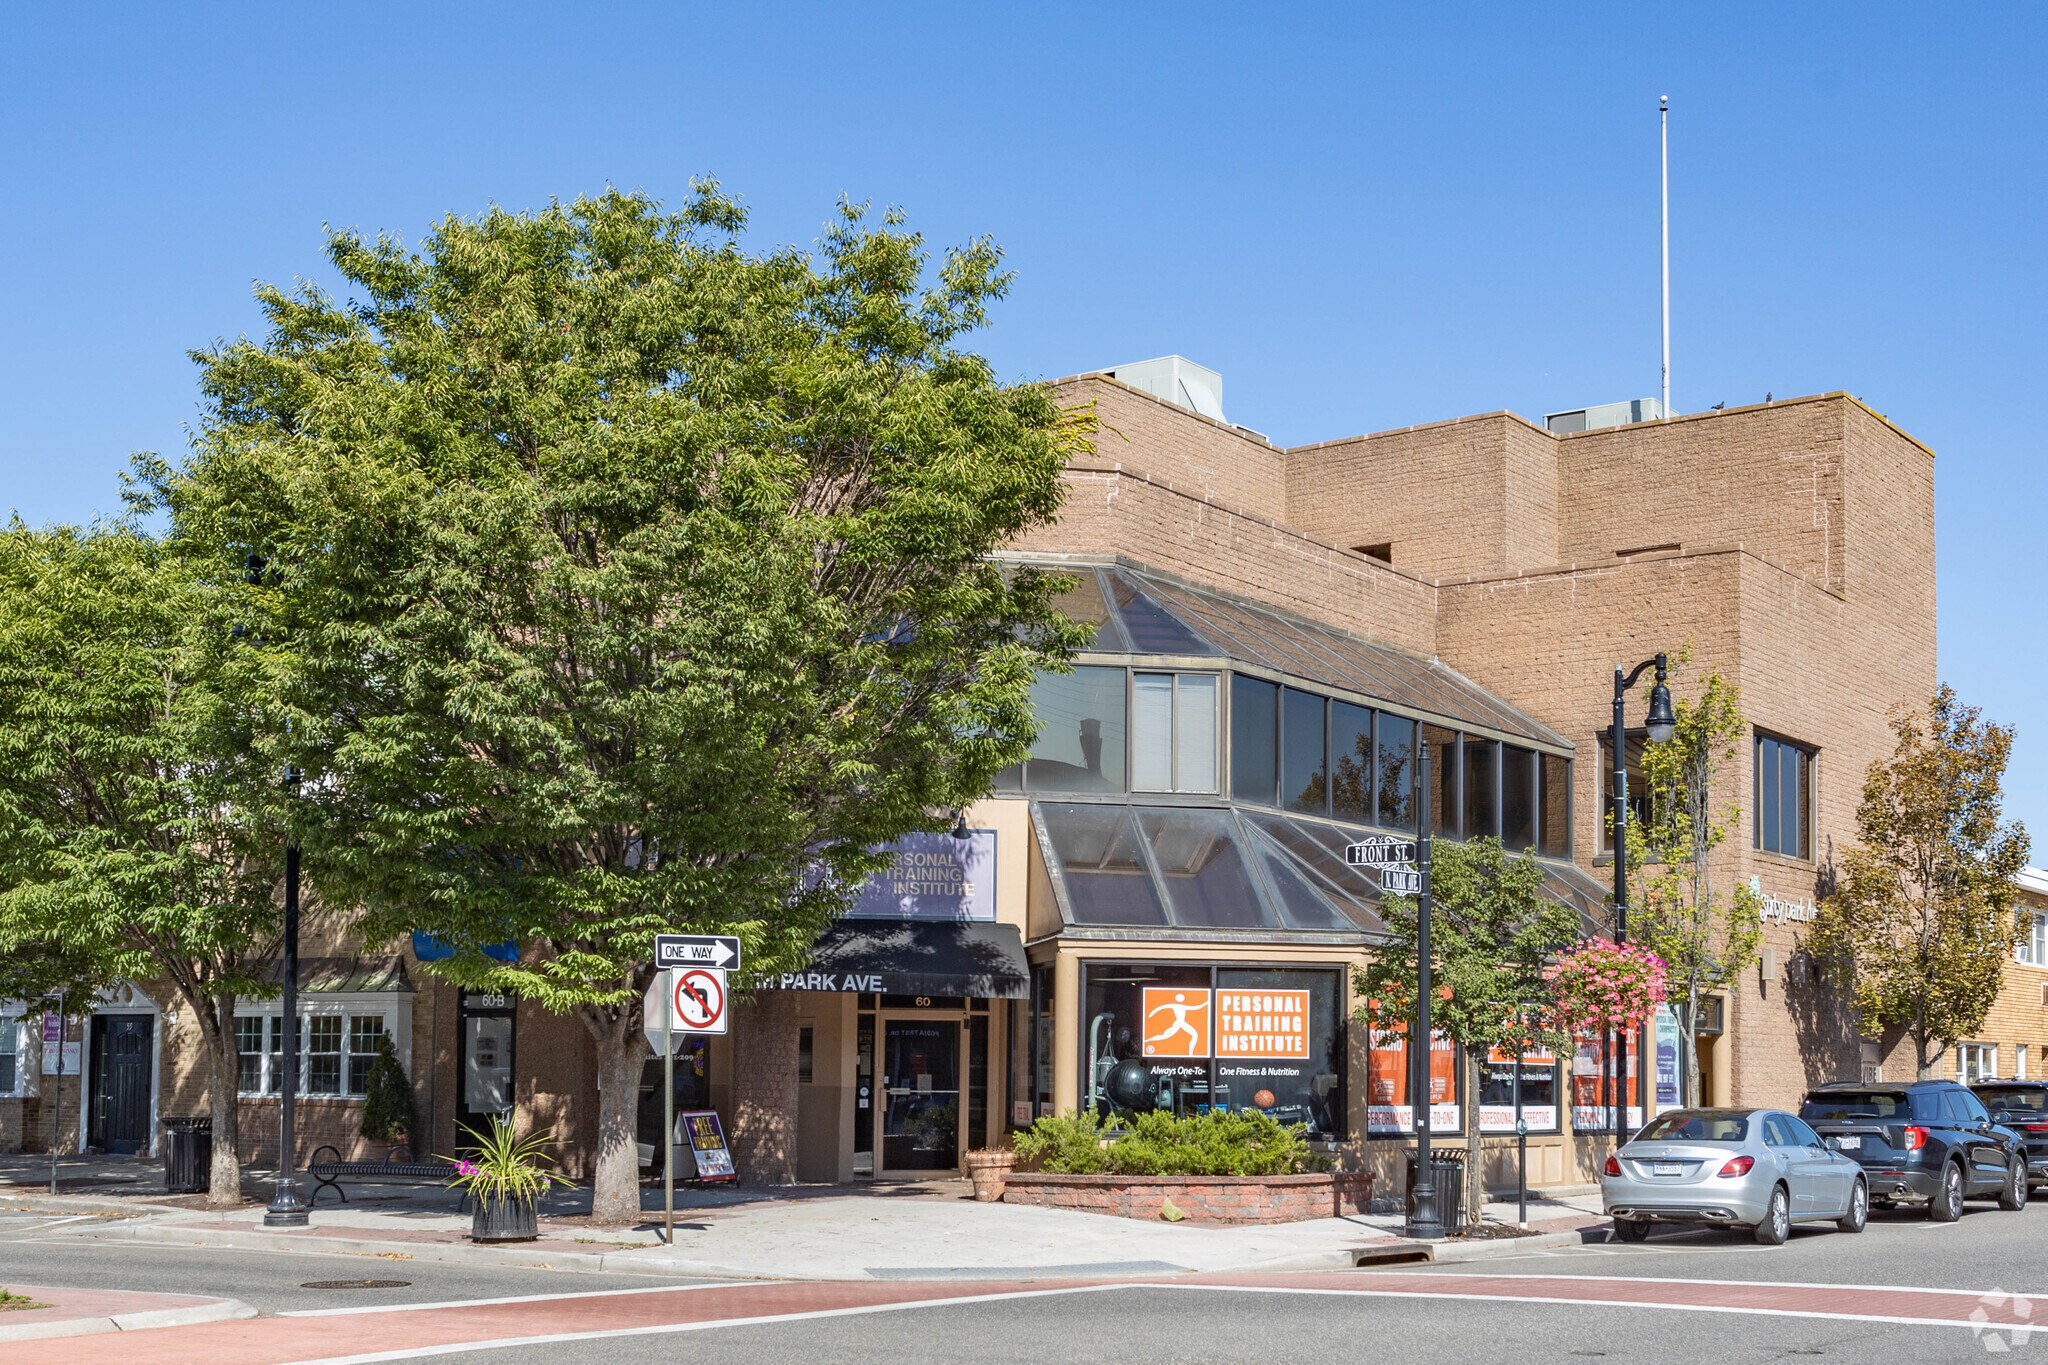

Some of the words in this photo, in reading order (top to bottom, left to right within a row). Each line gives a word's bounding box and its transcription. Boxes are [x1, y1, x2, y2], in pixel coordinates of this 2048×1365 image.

[895, 852, 957, 867] RSONAL
[1355, 845, 1389, 863] FRONT
[1395, 844, 1409, 861] ST.
[885, 867, 962, 881] TRAINING
[1392, 872, 1407, 890] PARK
[893, 881, 976, 896] INSTITUTE
[665, 945, 685, 958] ONE
[691, 946, 713, 959] WAY
[780, 973, 837, 991] PARK
[841, 974, 888, 992] AVE.
[915, 996, 931, 1007] 60
[1221, 995, 1302, 1013] PERSONAL
[126, 1022, 134, 1031] 55
[1222, 1015, 1302, 1032] TRAINING
[1222, 1035, 1302, 1052] INSTITUTE
[1150, 1065, 1176, 1076] Always
[1177, 1066, 1206, 1076] One-To-
[1219, 1067, 1235, 1076] One
[1236, 1066, 1260, 1076] Fitness
[1260, 1067, 1267, 1076] &
[1267, 1067, 1300, 1076] Nutrition
[1368, 1111, 1411, 1125] PERFORMANCE
[1479, 1111, 1515, 1125] ROFESSIONAL
[1524, 1111, 1549, 1124] EFFECTIVE
[692, 1116, 715, 1135] FREE
